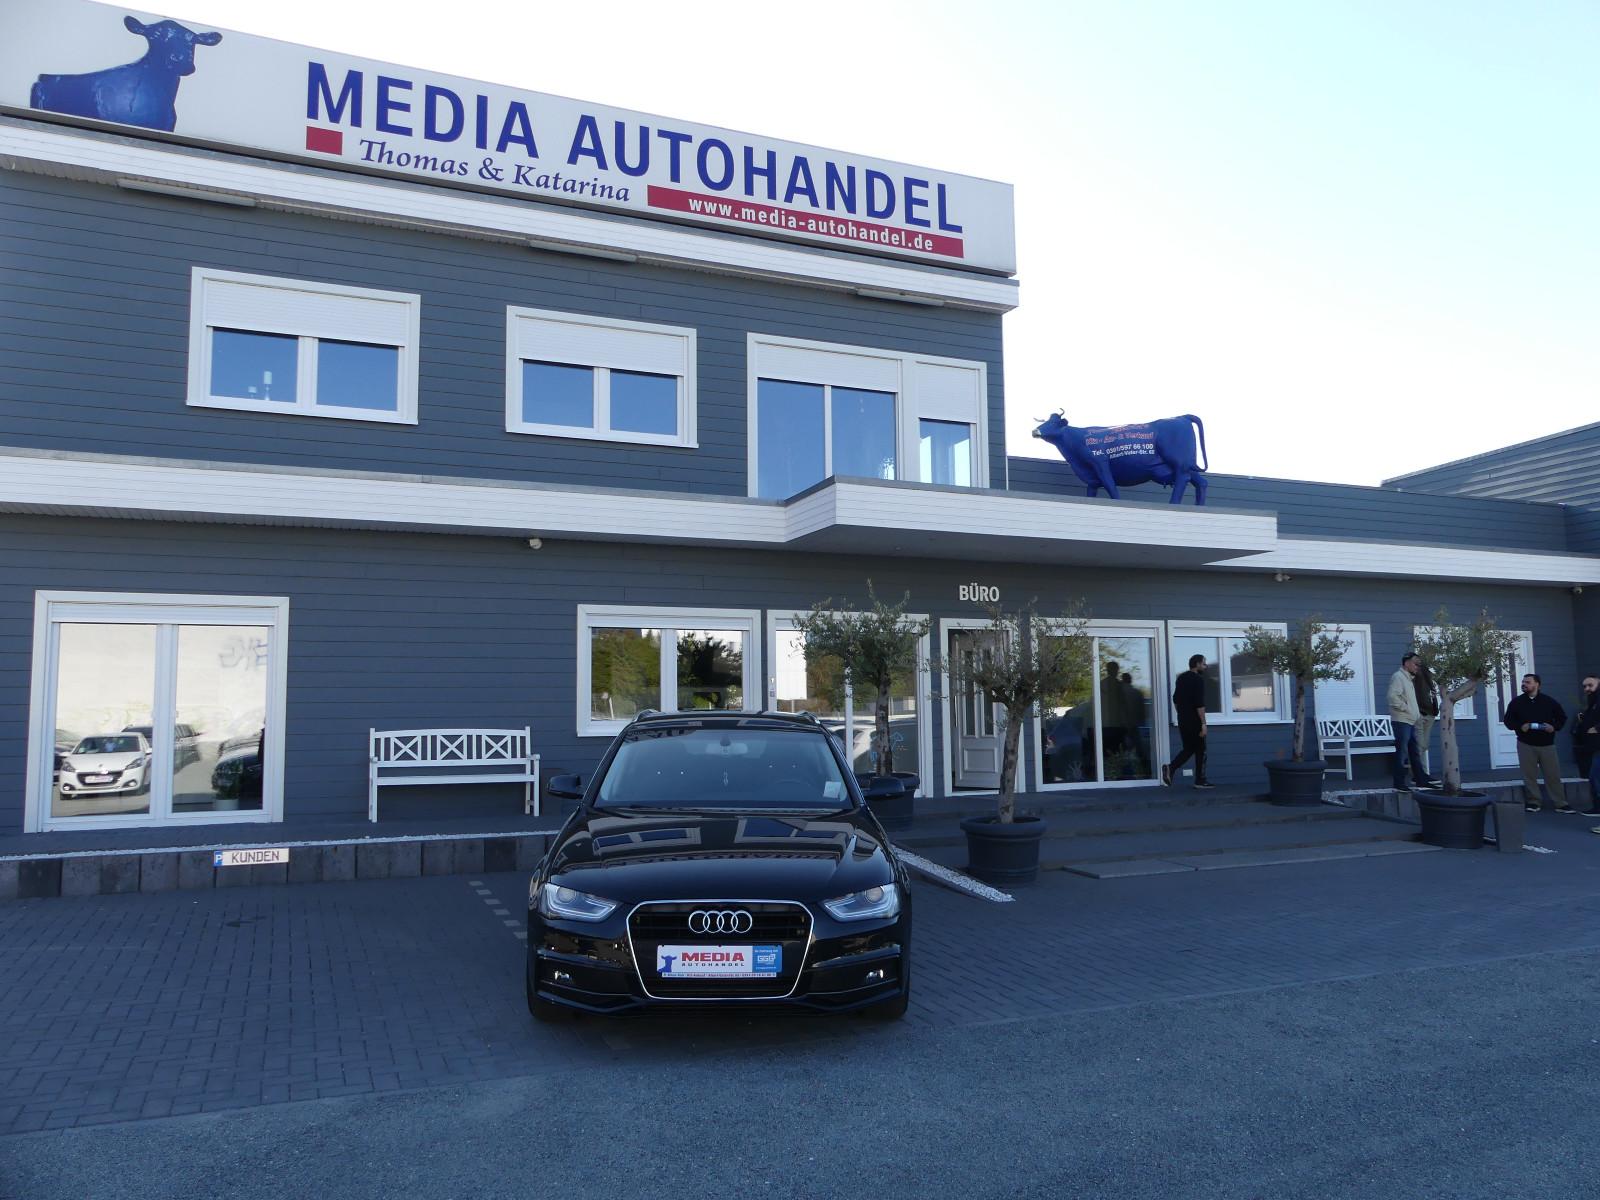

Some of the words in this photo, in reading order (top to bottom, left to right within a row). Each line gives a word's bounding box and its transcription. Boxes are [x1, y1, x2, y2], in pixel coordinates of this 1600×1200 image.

[307, 61, 540, 159] MEDIA
[567, 114, 963, 234] AUTOHANDEL
[359, 138, 469, 177] Thomas
[478, 157, 505, 182] &
[512, 163, 631, 202] Katarina
[688, 197, 934, 252] www.media-autohandel.de
[959, 582, 1000, 602] BÜRO
[231, 851, 279, 863] KUNDEN
[682, 952, 744, 961] MEDIA
